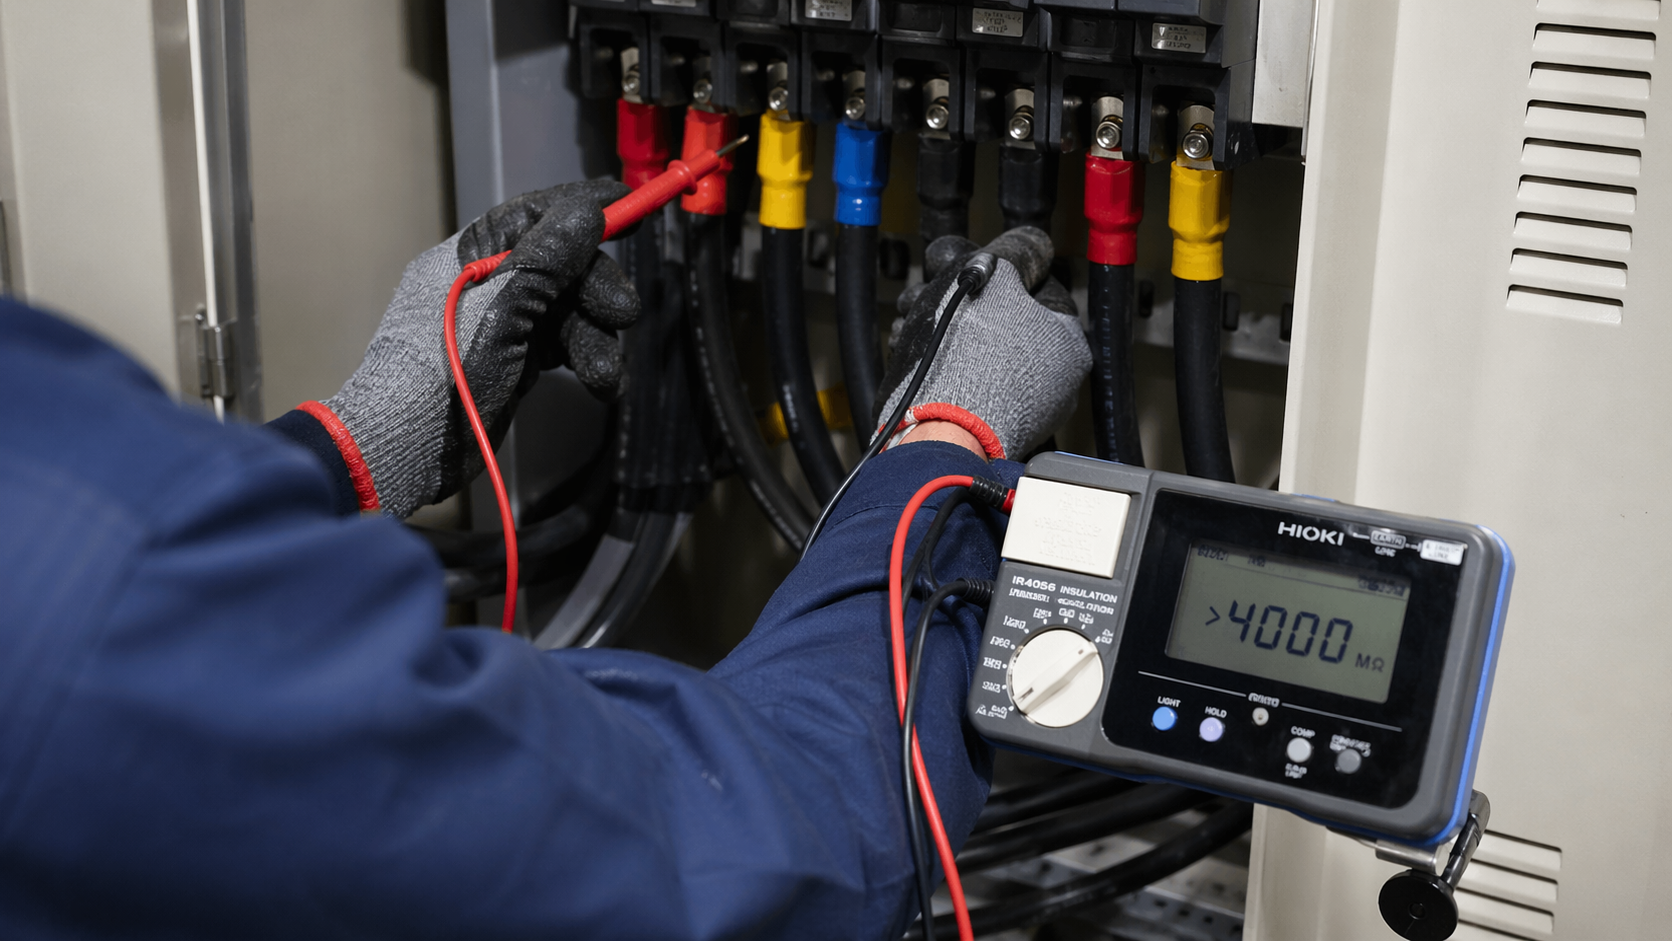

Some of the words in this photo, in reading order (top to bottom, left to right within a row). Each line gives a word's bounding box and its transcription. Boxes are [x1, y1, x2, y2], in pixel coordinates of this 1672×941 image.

[1277, 521, 1345, 546] HIOKI
[1060, 585, 1118, 603] INSULATION
[1157, 696, 1182, 708] LIGHT
[1205, 706, 1227, 718] HOLD
[1290, 726, 1316, 739] COMP
